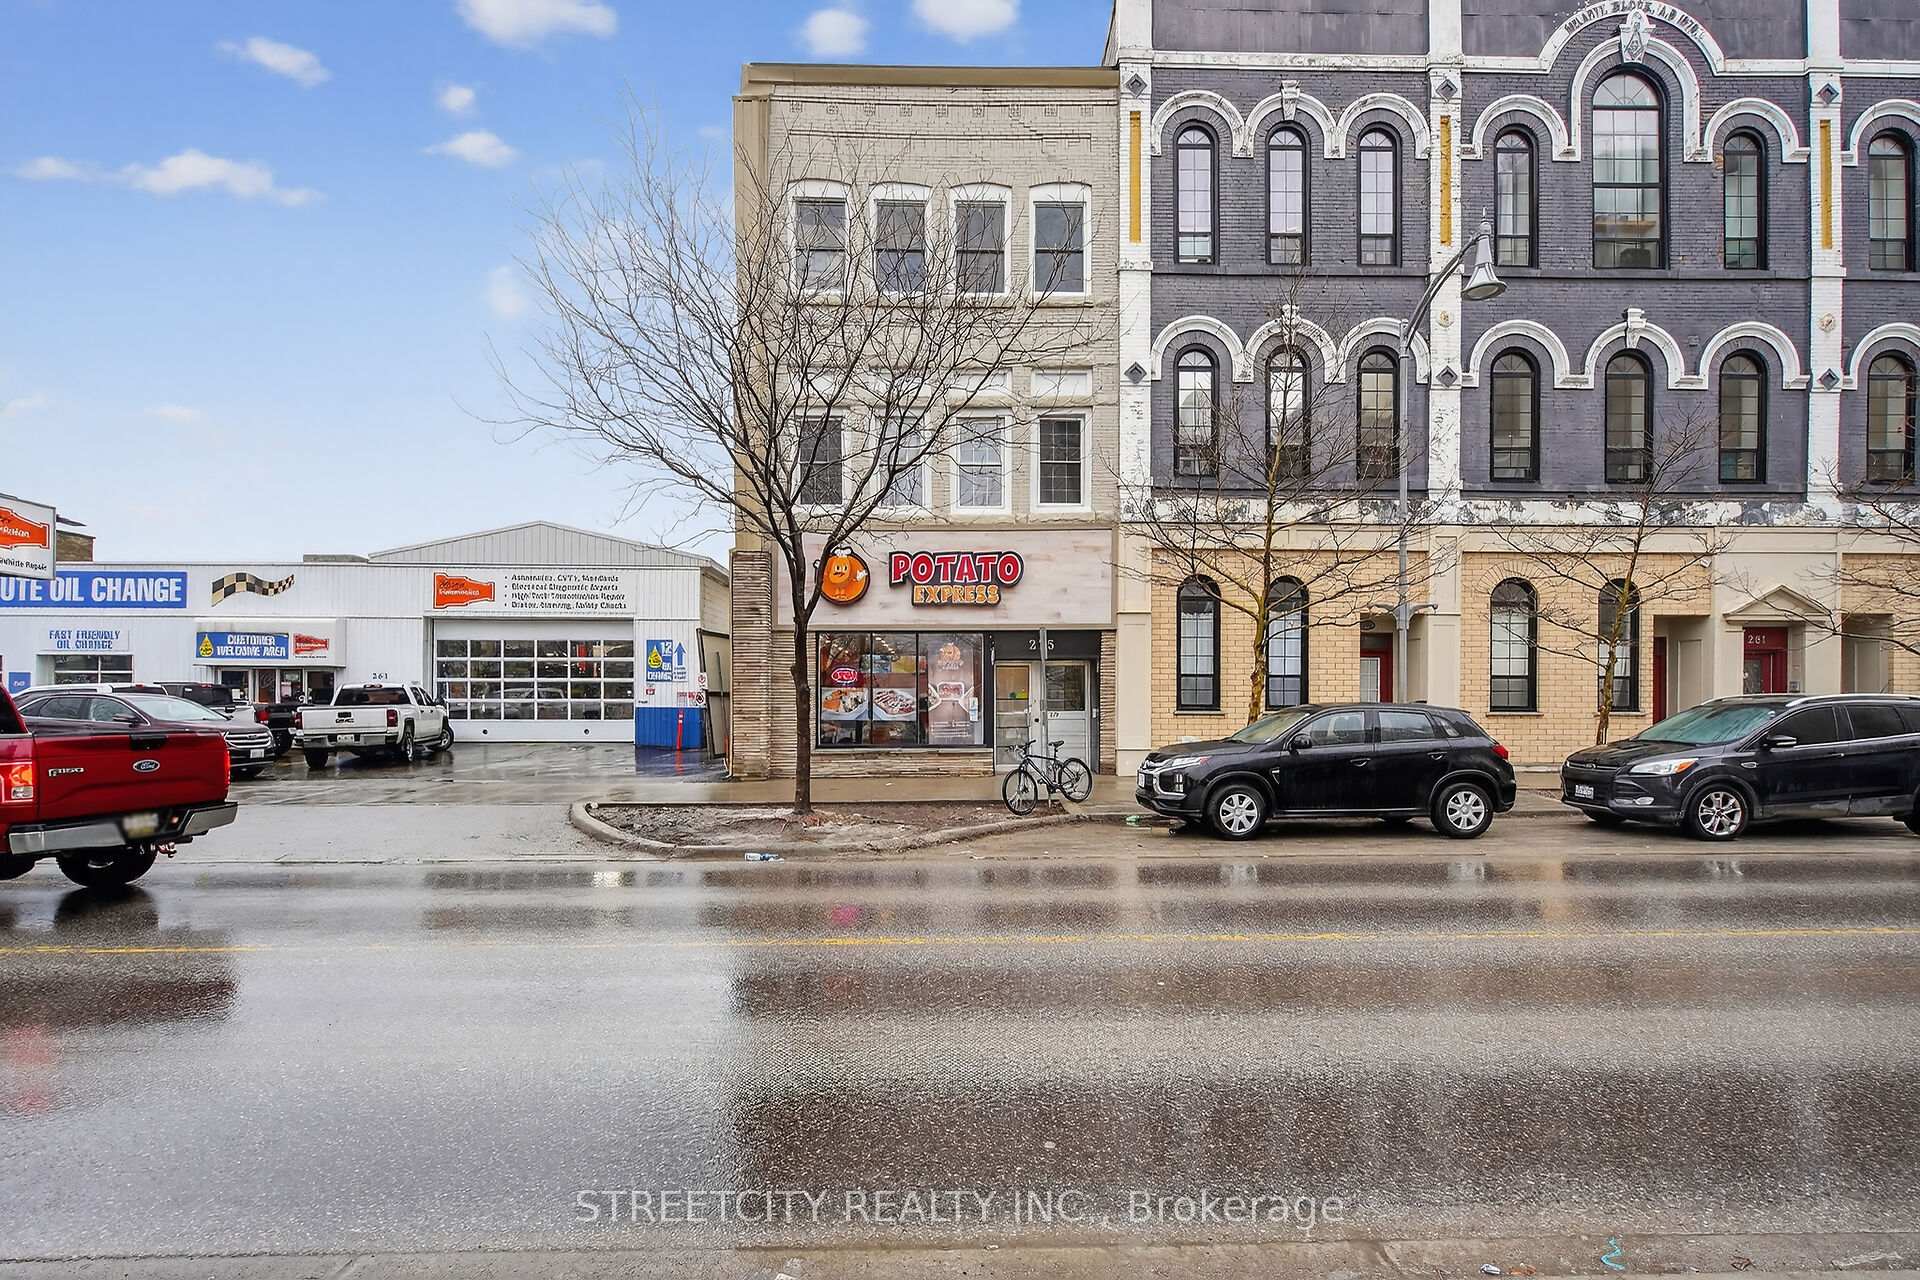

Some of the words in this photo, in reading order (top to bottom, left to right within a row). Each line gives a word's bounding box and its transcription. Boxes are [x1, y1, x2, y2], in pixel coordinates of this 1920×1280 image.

[890, 552, 1022, 585] POTATO
[50, 577, 85, 602] OIL
[91, 577, 182, 602] CHANGE
[913, 584, 1000, 604] EXPRESS
[49, 630, 72, 640] FAST
[76, 630, 120, 640] FRIENDLY
[227, 634, 275, 646] CUSTOMER
[56, 640, 71, 649] OIL
[75, 640, 113, 649] CHANGE
[1028, 639, 1055, 650] 25
[263, 646, 286, 656] AREA
